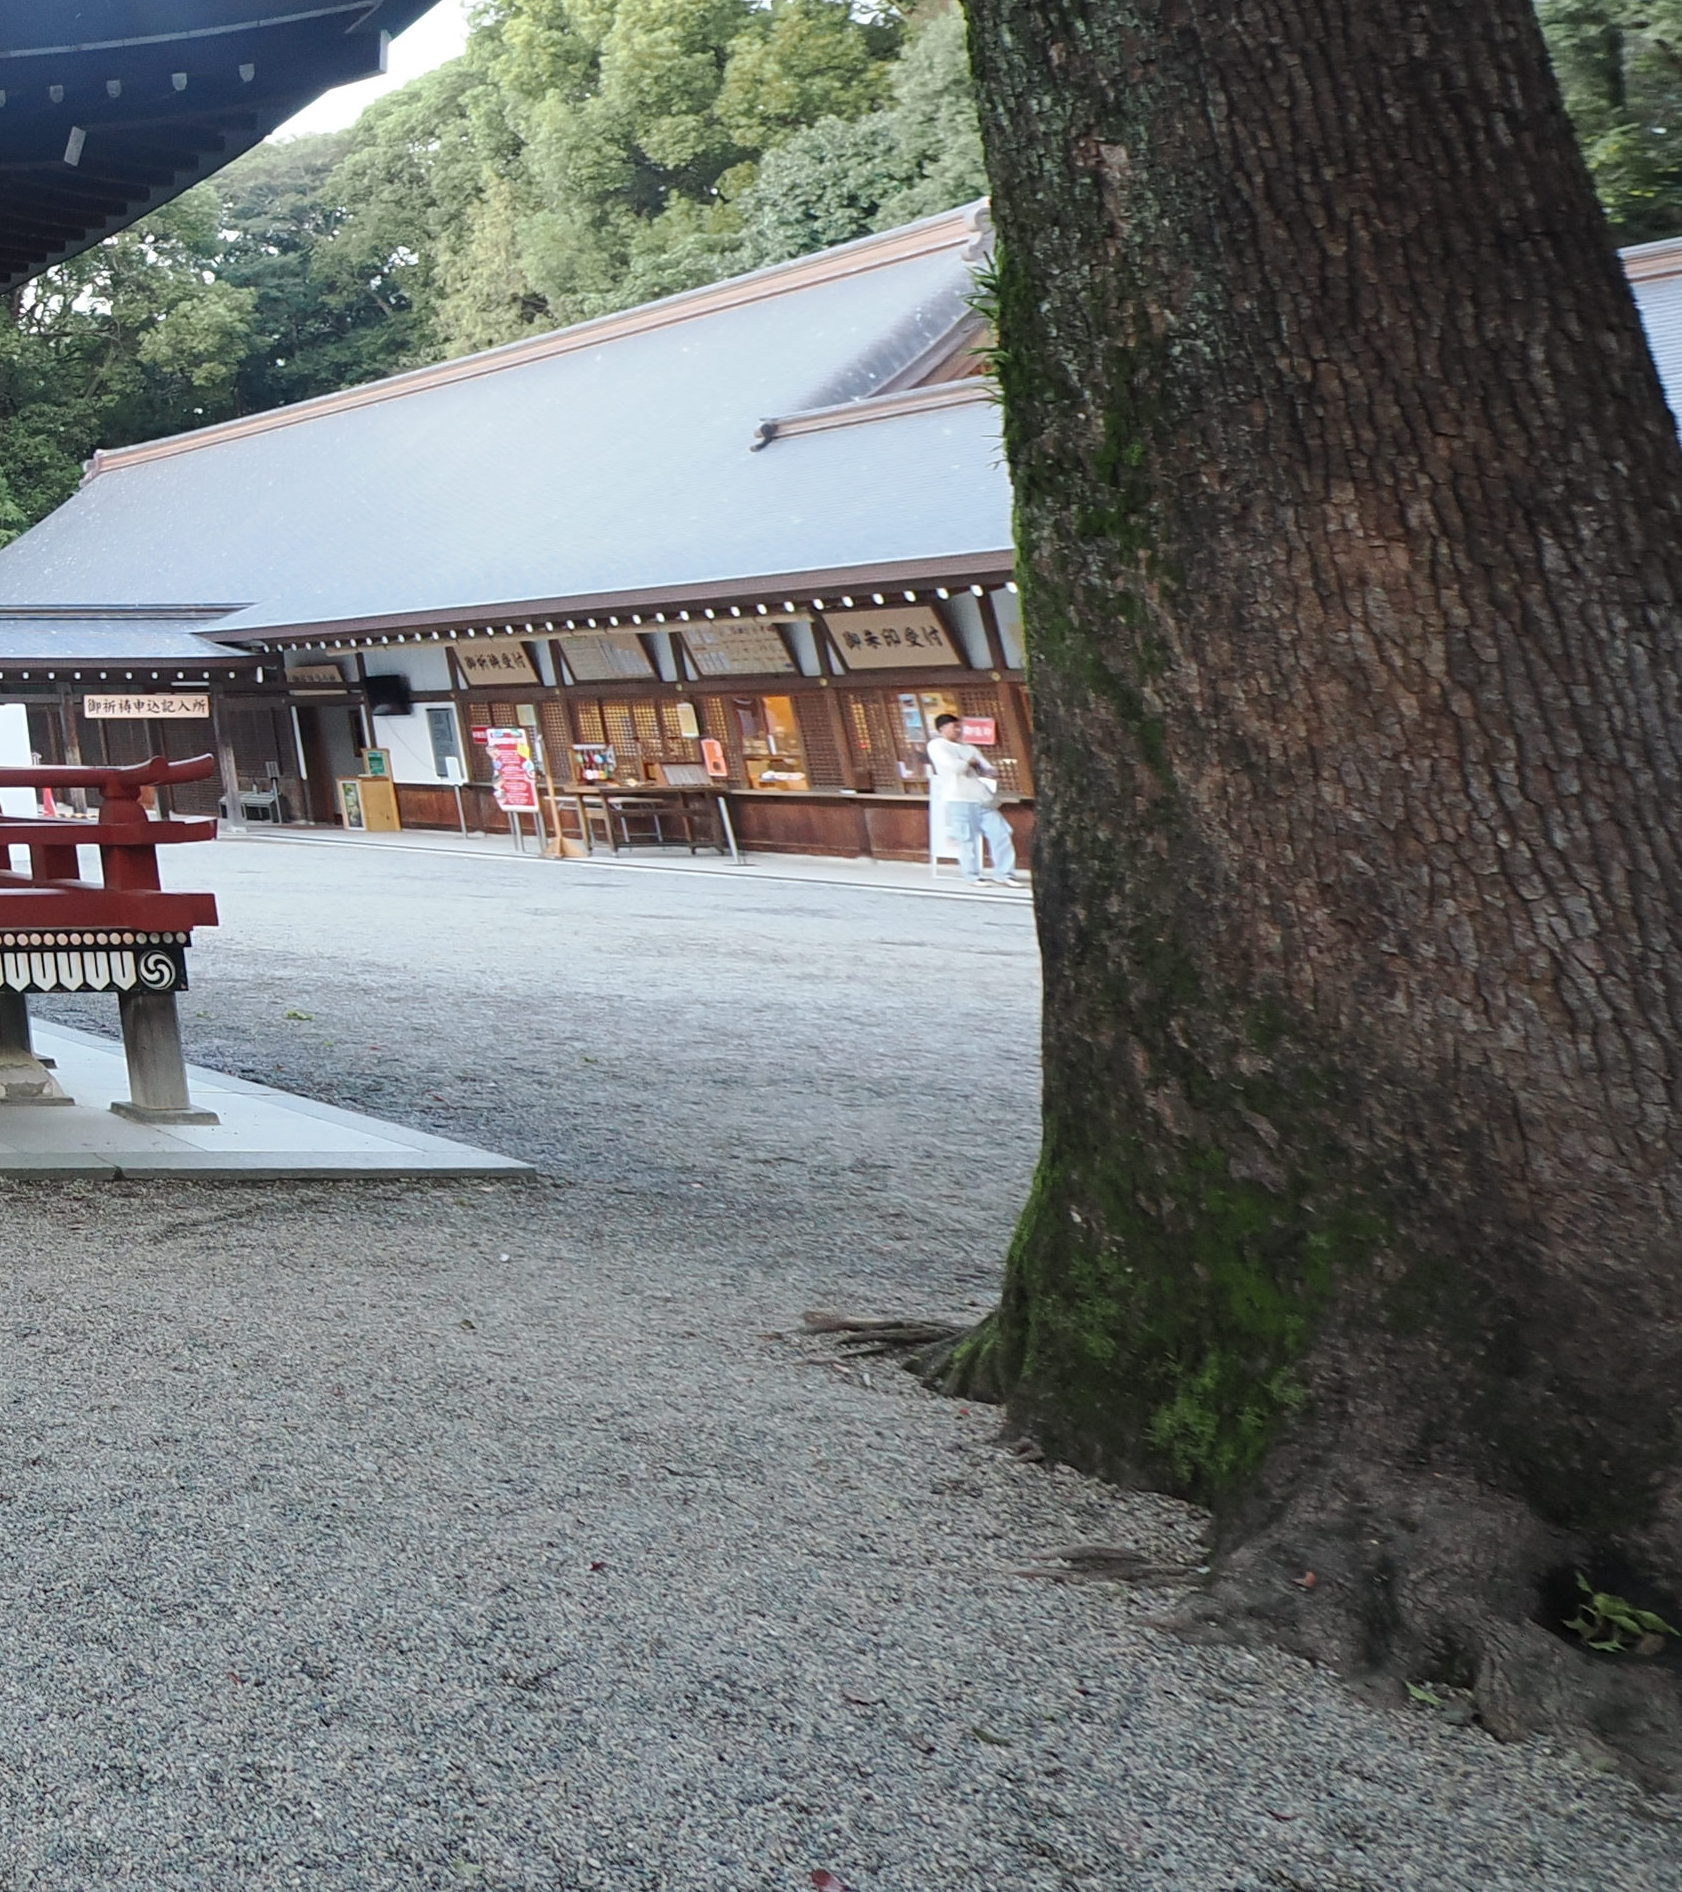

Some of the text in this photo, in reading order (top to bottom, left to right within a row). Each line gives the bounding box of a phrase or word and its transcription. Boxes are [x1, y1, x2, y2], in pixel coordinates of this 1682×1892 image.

[842, 625, 943, 651] 御朱印受付
